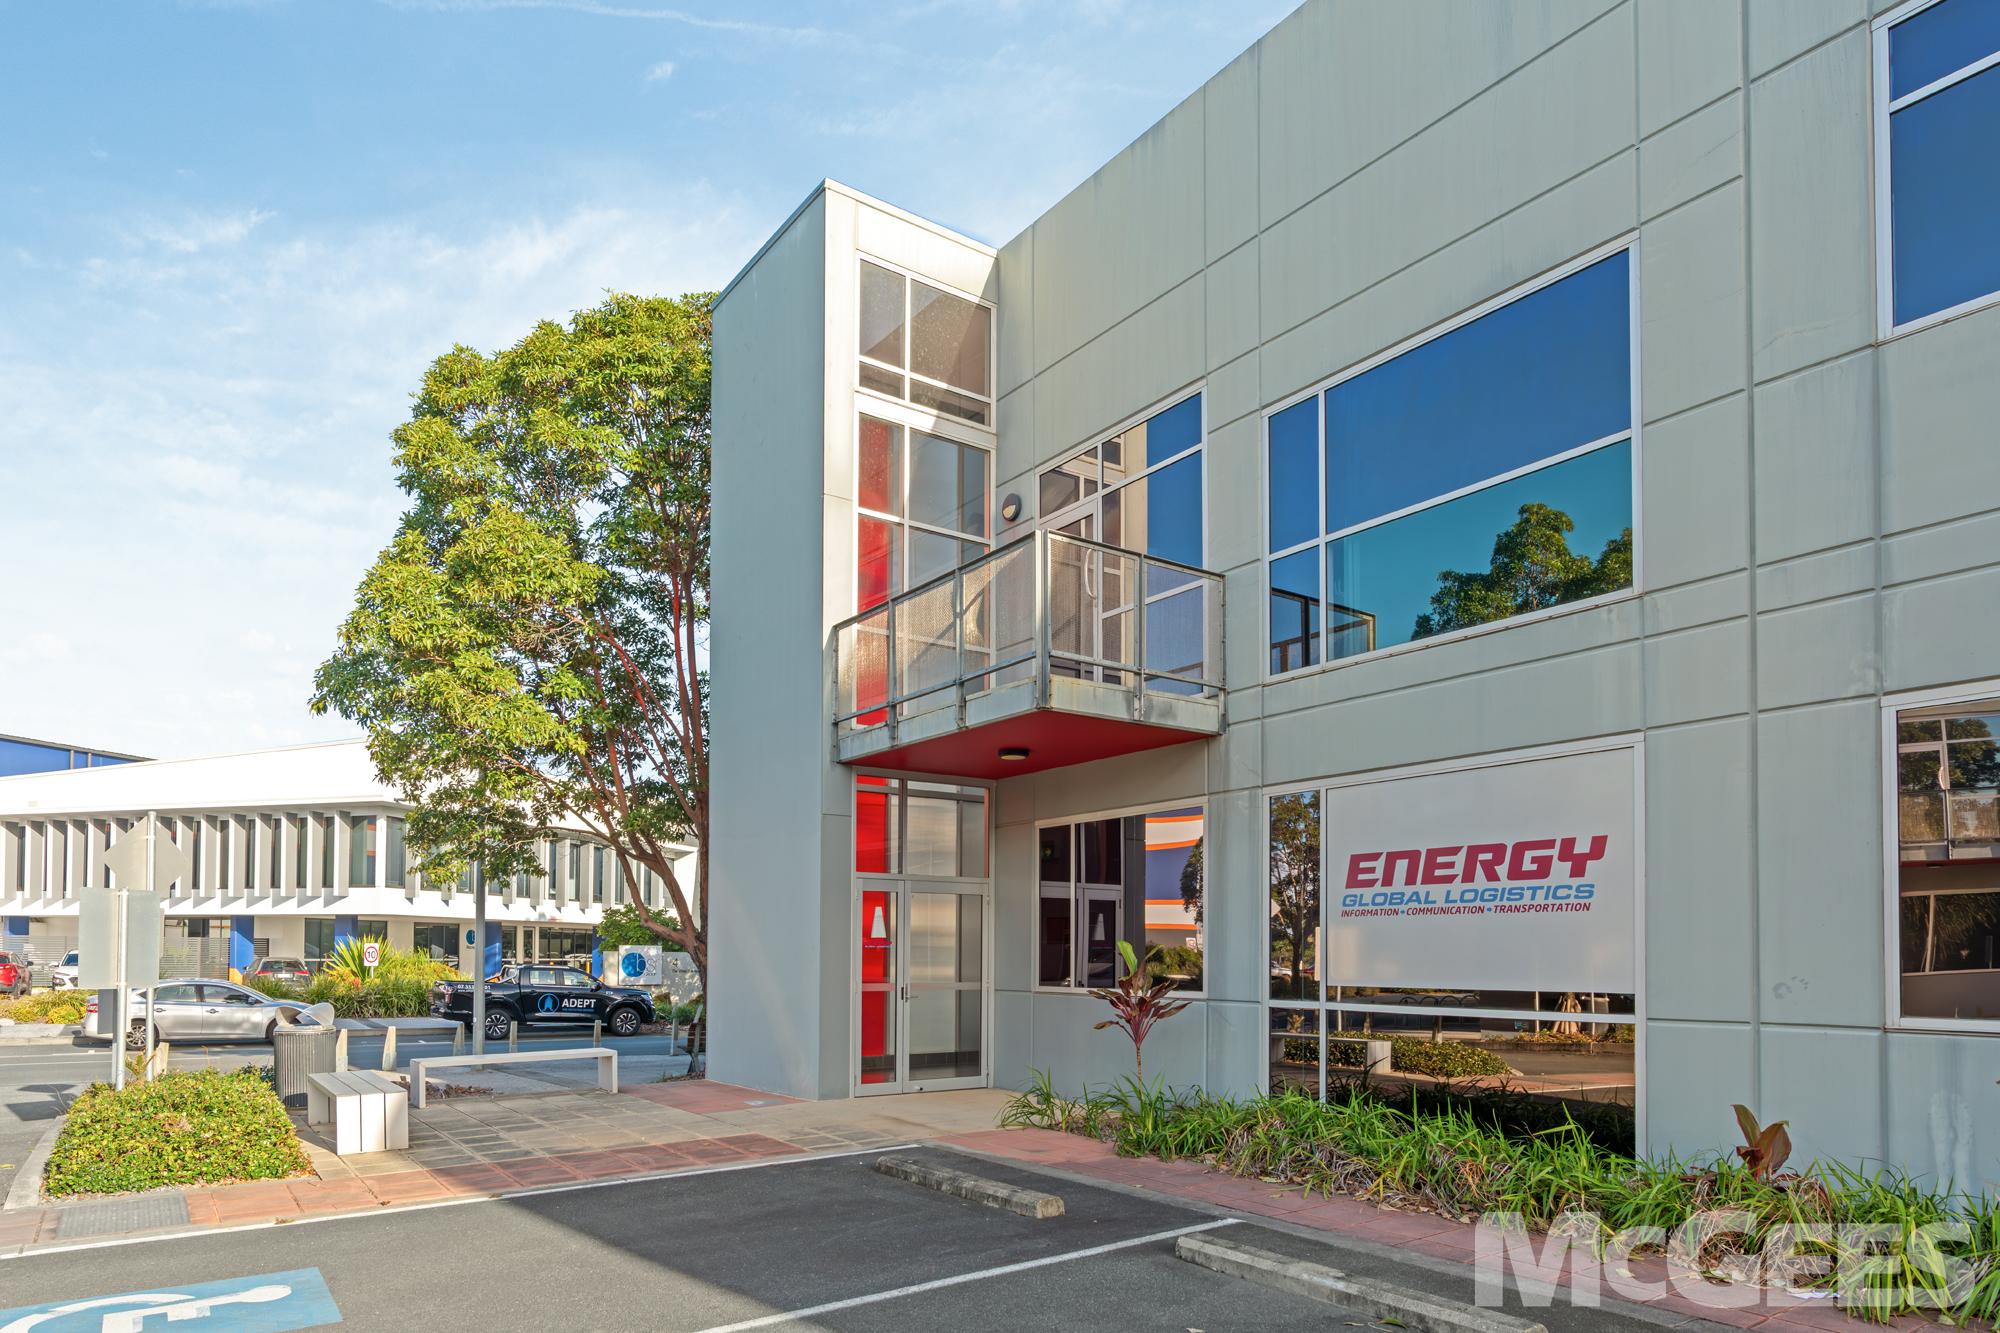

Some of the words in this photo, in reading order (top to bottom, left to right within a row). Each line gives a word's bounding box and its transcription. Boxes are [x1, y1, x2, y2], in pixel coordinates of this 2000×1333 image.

[1342, 890, 1437, 907] GLOBAL
[1444, 883, 1595, 904] LOGISTICS
[1341, 908, 1399, 918] INFORMATION
[1406, 905, 1485, 916] COMMUNICATION
[1493, 902, 1591, 913] TRANSPORTATION
[367, 951, 376, 959] 10
[561, 998, 597, 1008] ADEPT
